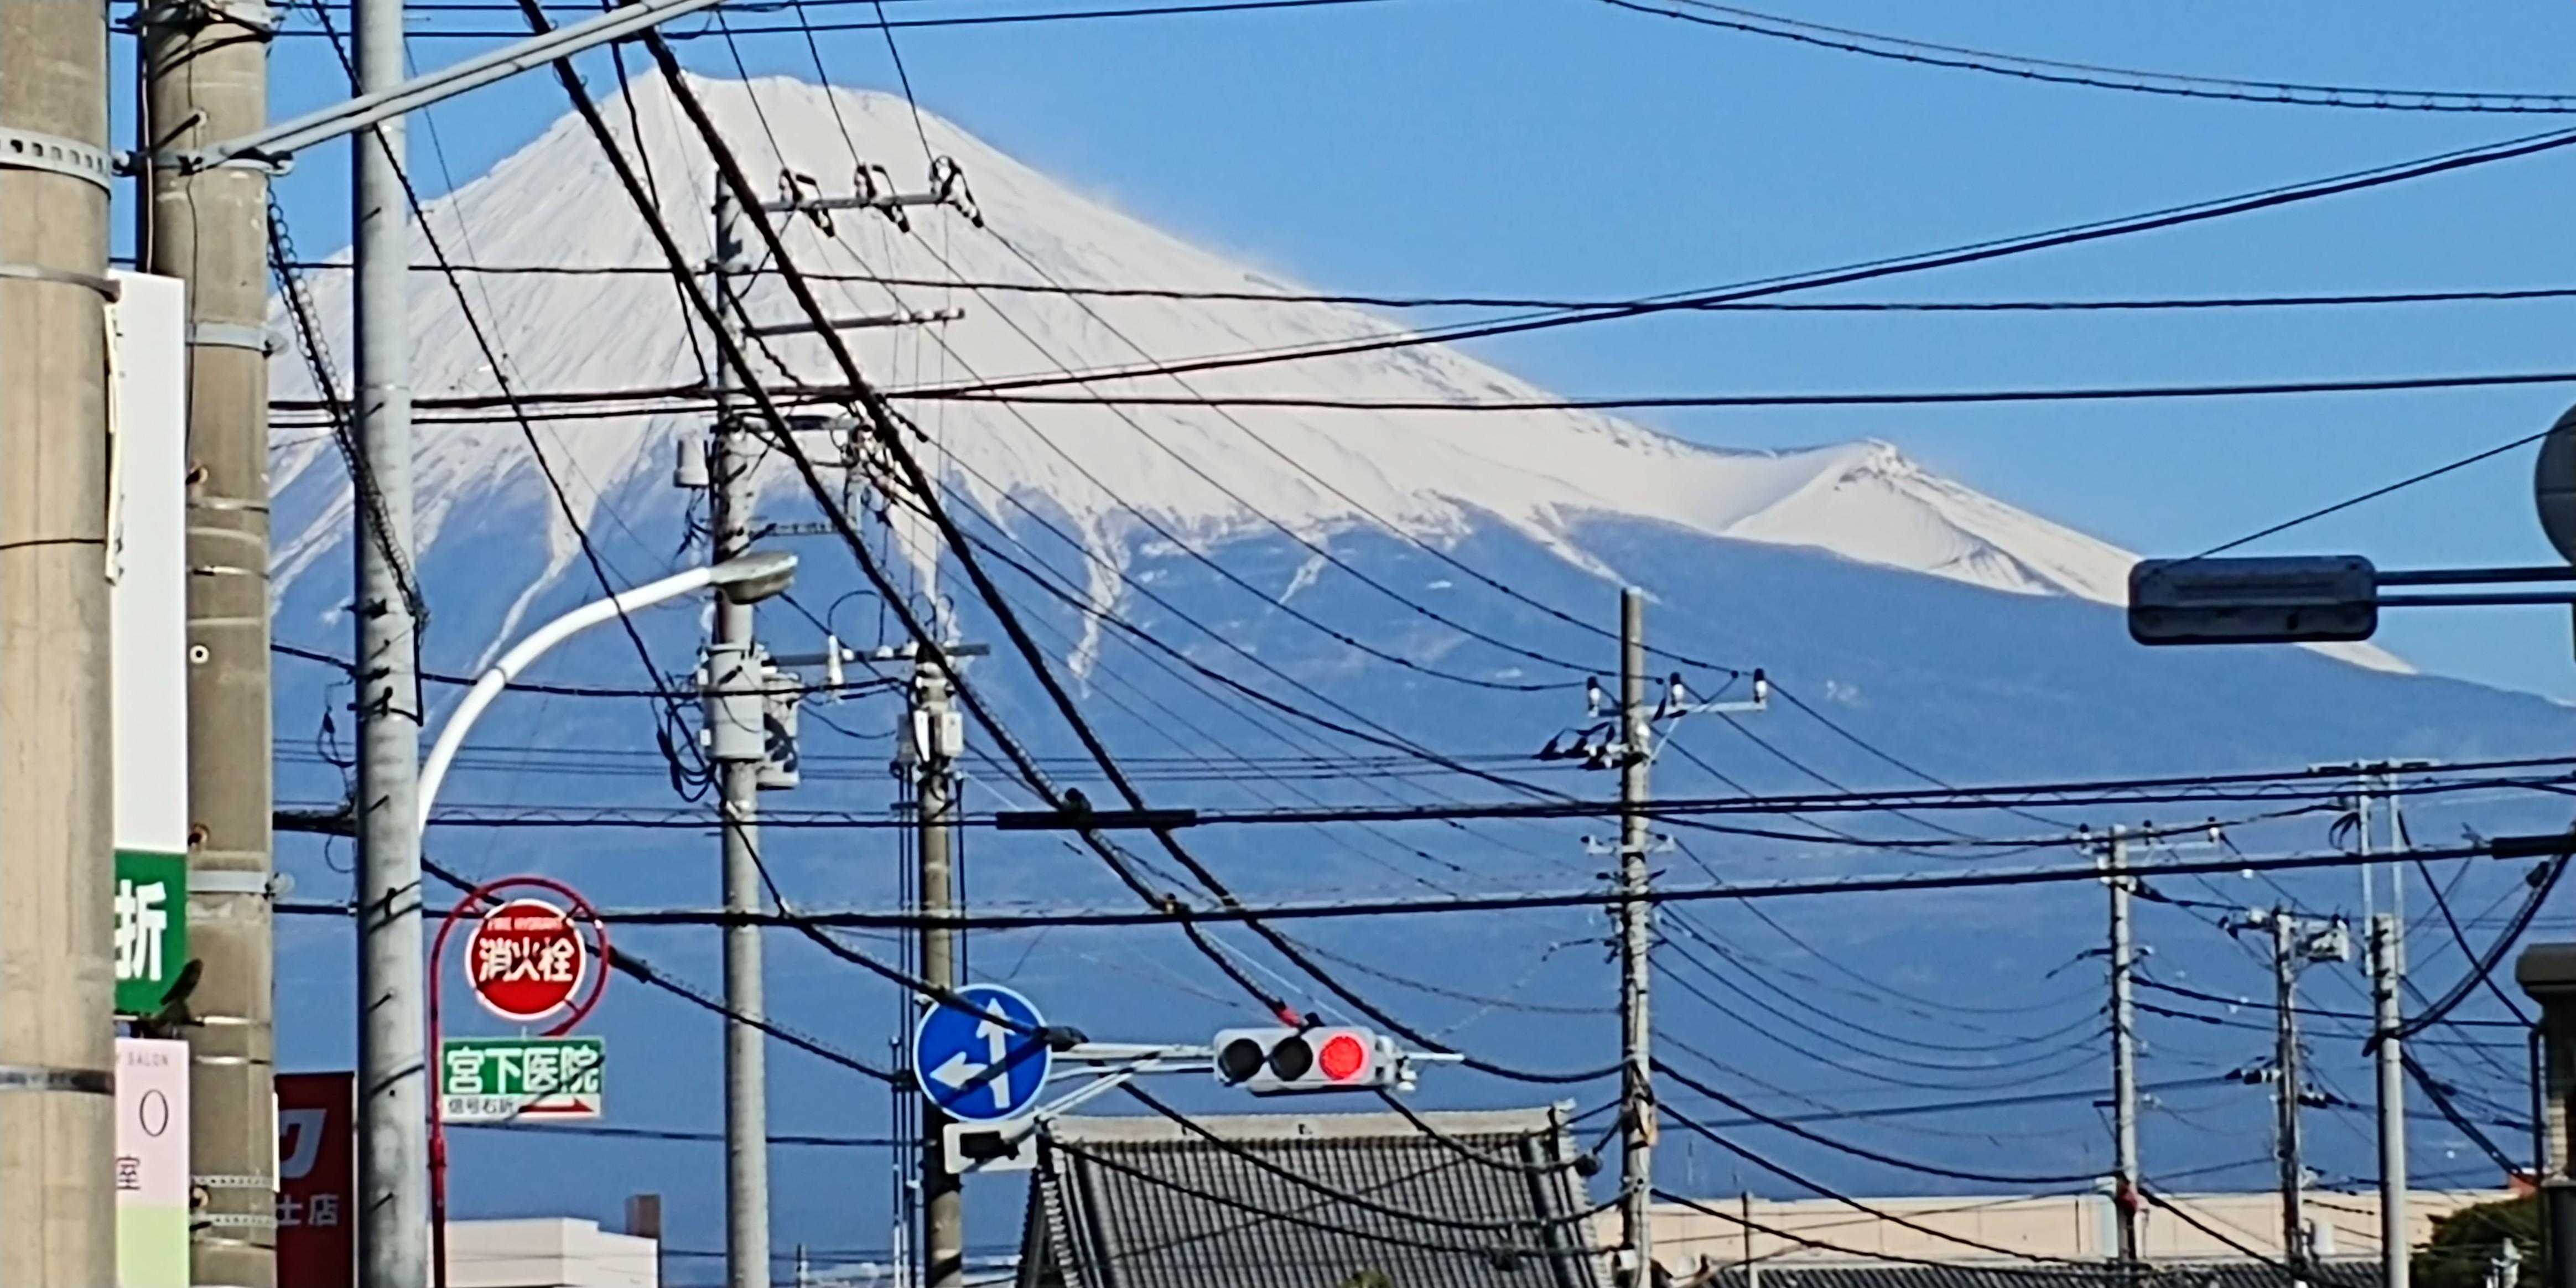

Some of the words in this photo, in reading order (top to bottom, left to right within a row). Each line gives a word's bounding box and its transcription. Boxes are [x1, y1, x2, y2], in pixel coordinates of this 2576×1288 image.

[479, 937, 575, 982] 消火栓
[128, 1052, 168, 1066] SALON
[447, 1045, 599, 1094] 宮下医院
